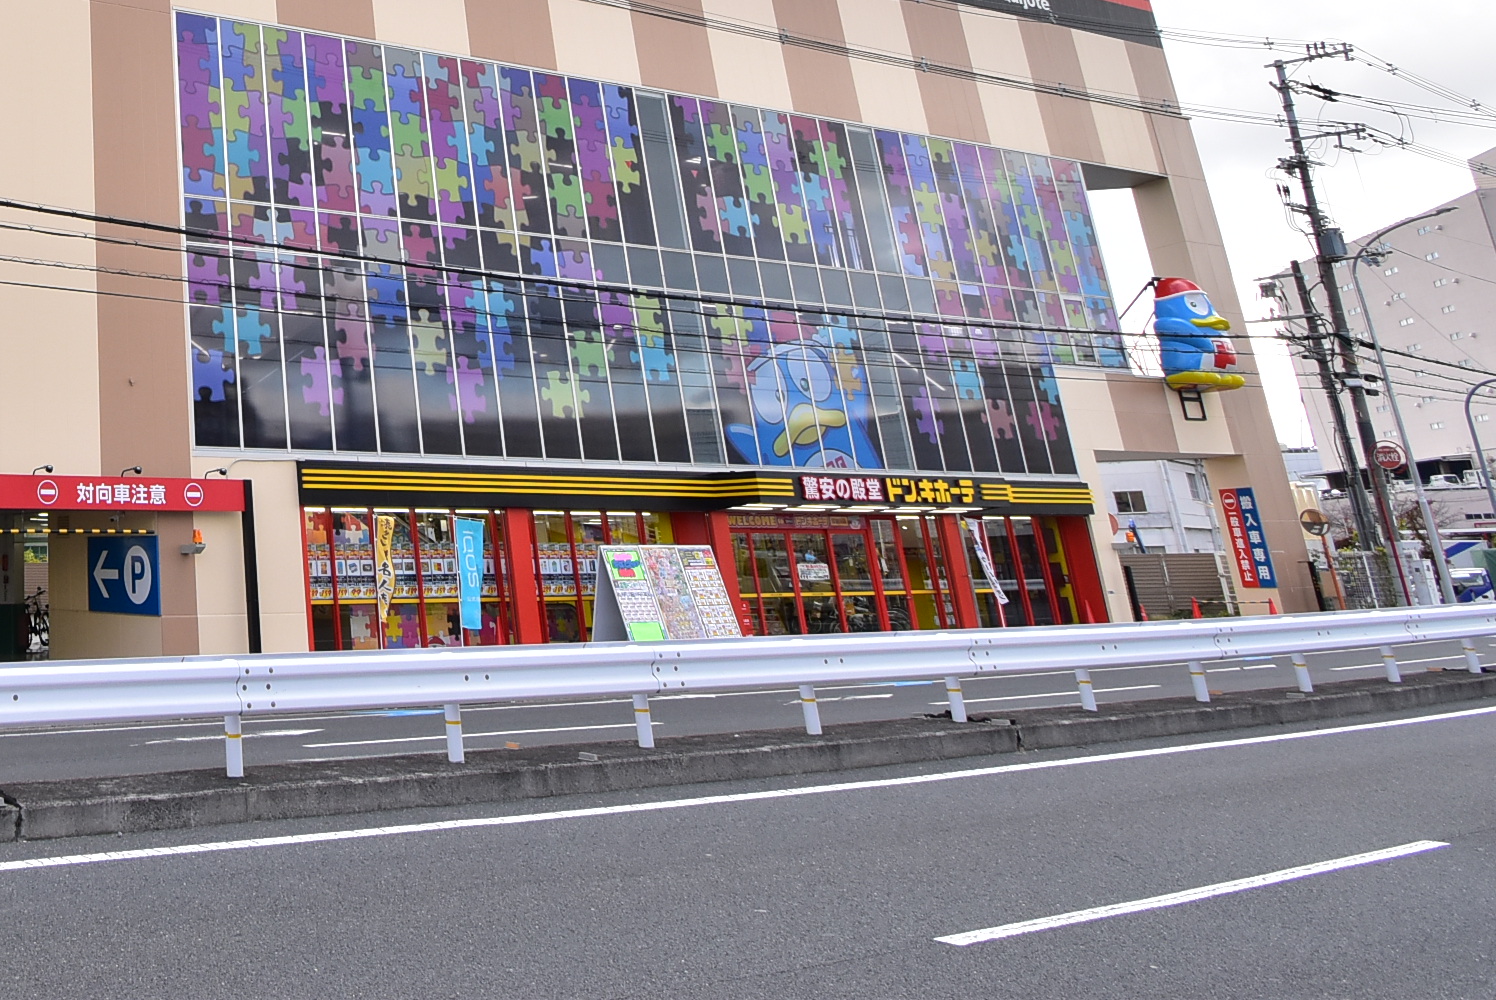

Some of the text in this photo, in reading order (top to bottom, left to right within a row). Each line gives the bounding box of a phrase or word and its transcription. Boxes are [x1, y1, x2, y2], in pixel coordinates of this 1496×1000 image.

[76, 482, 167, 505] 対向車注意
[801, 475, 976, 504] 驚安の殿堂 ドン.キホーテ
[727, 514, 777, 528] WELCOME
[1239, 495, 1272, 580] 搬入車専用
[130, 555, 146, 595] P
[462, 530, 480, 588] IQOS
